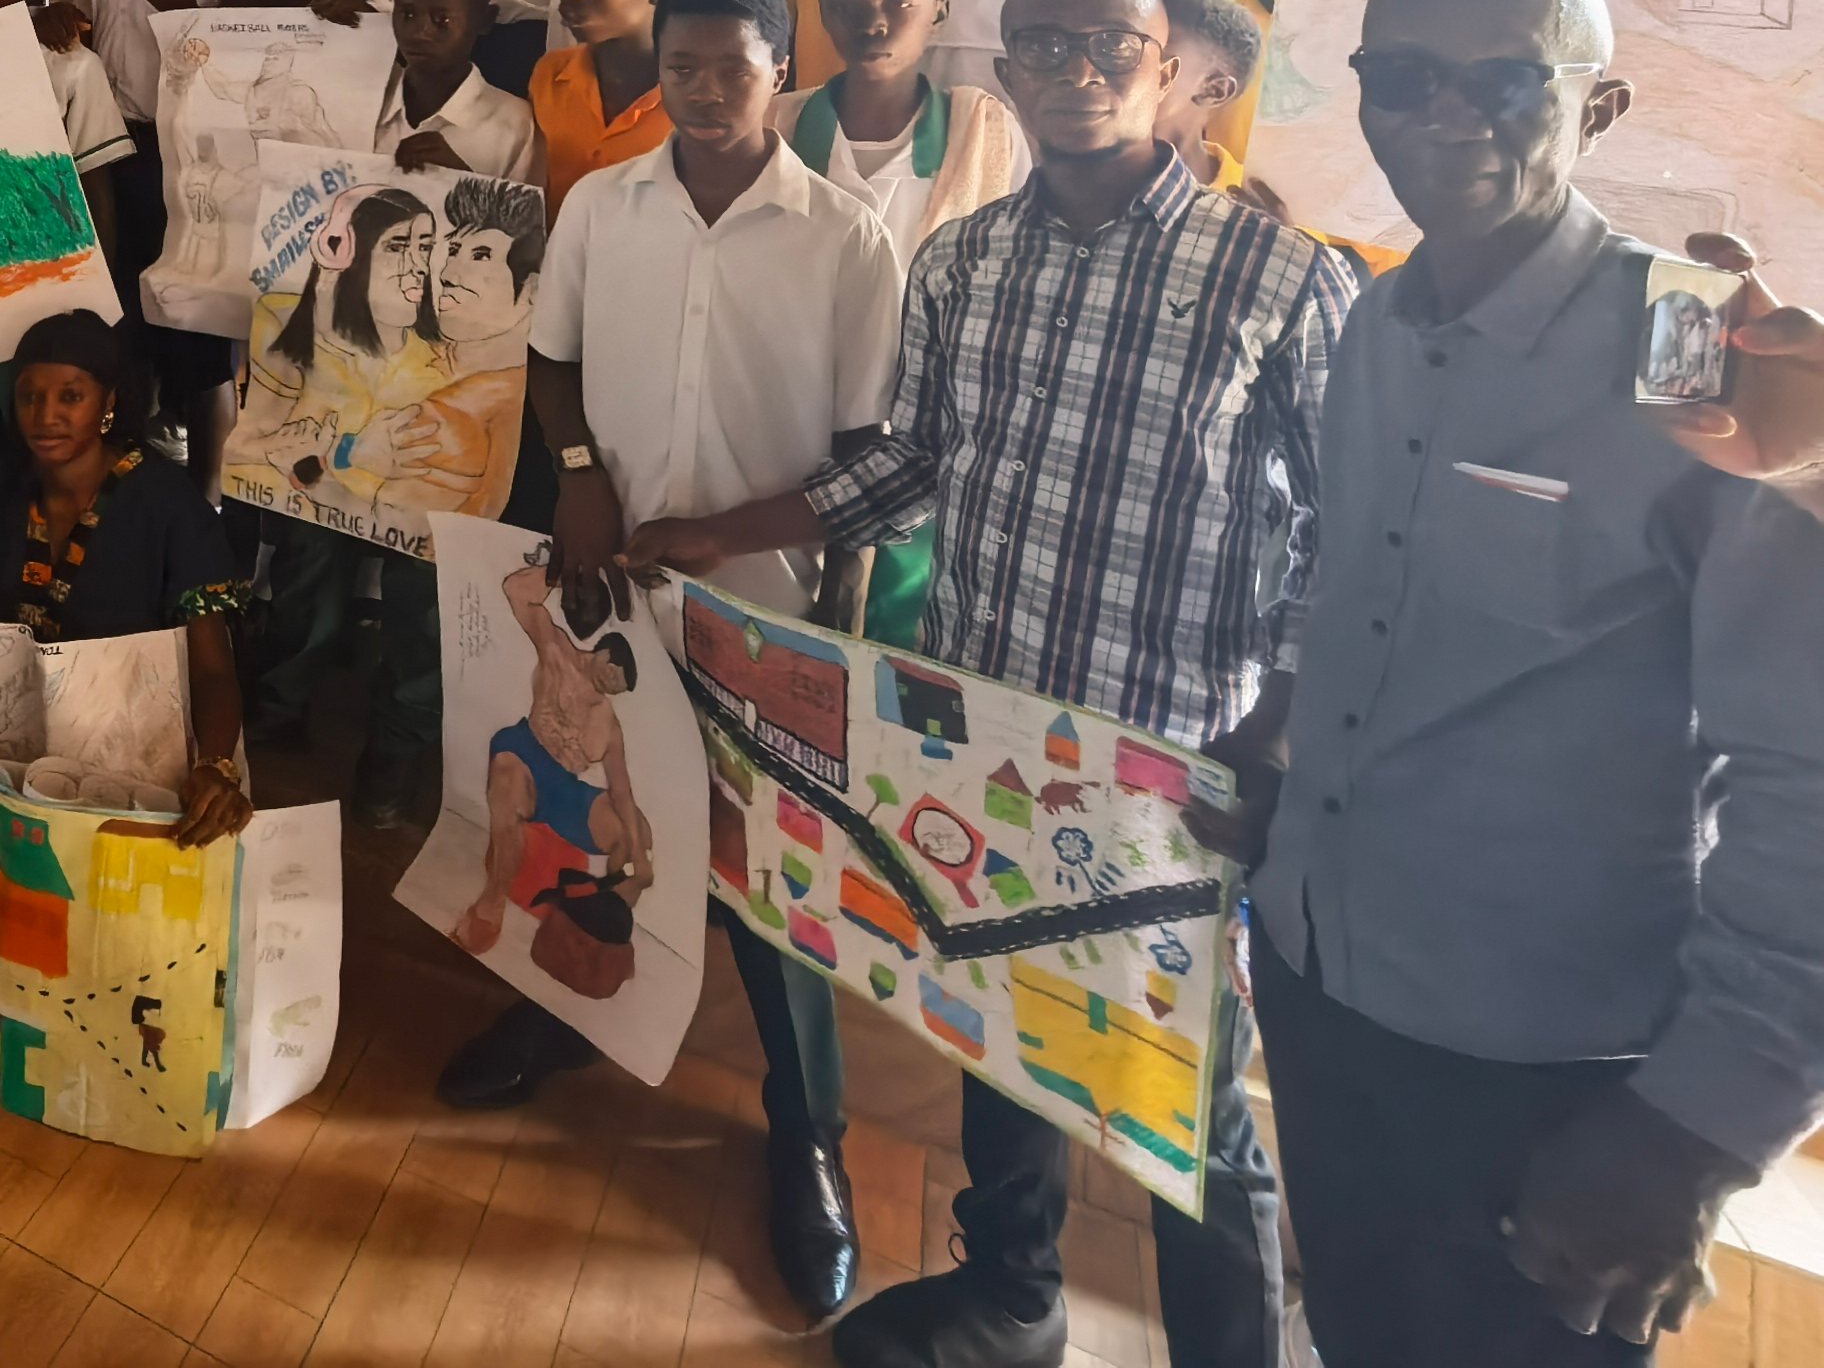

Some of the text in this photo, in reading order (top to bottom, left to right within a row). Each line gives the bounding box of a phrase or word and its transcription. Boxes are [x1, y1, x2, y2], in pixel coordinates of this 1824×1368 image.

[231, 475, 428, 558] THIS IS TRUE LOVE
